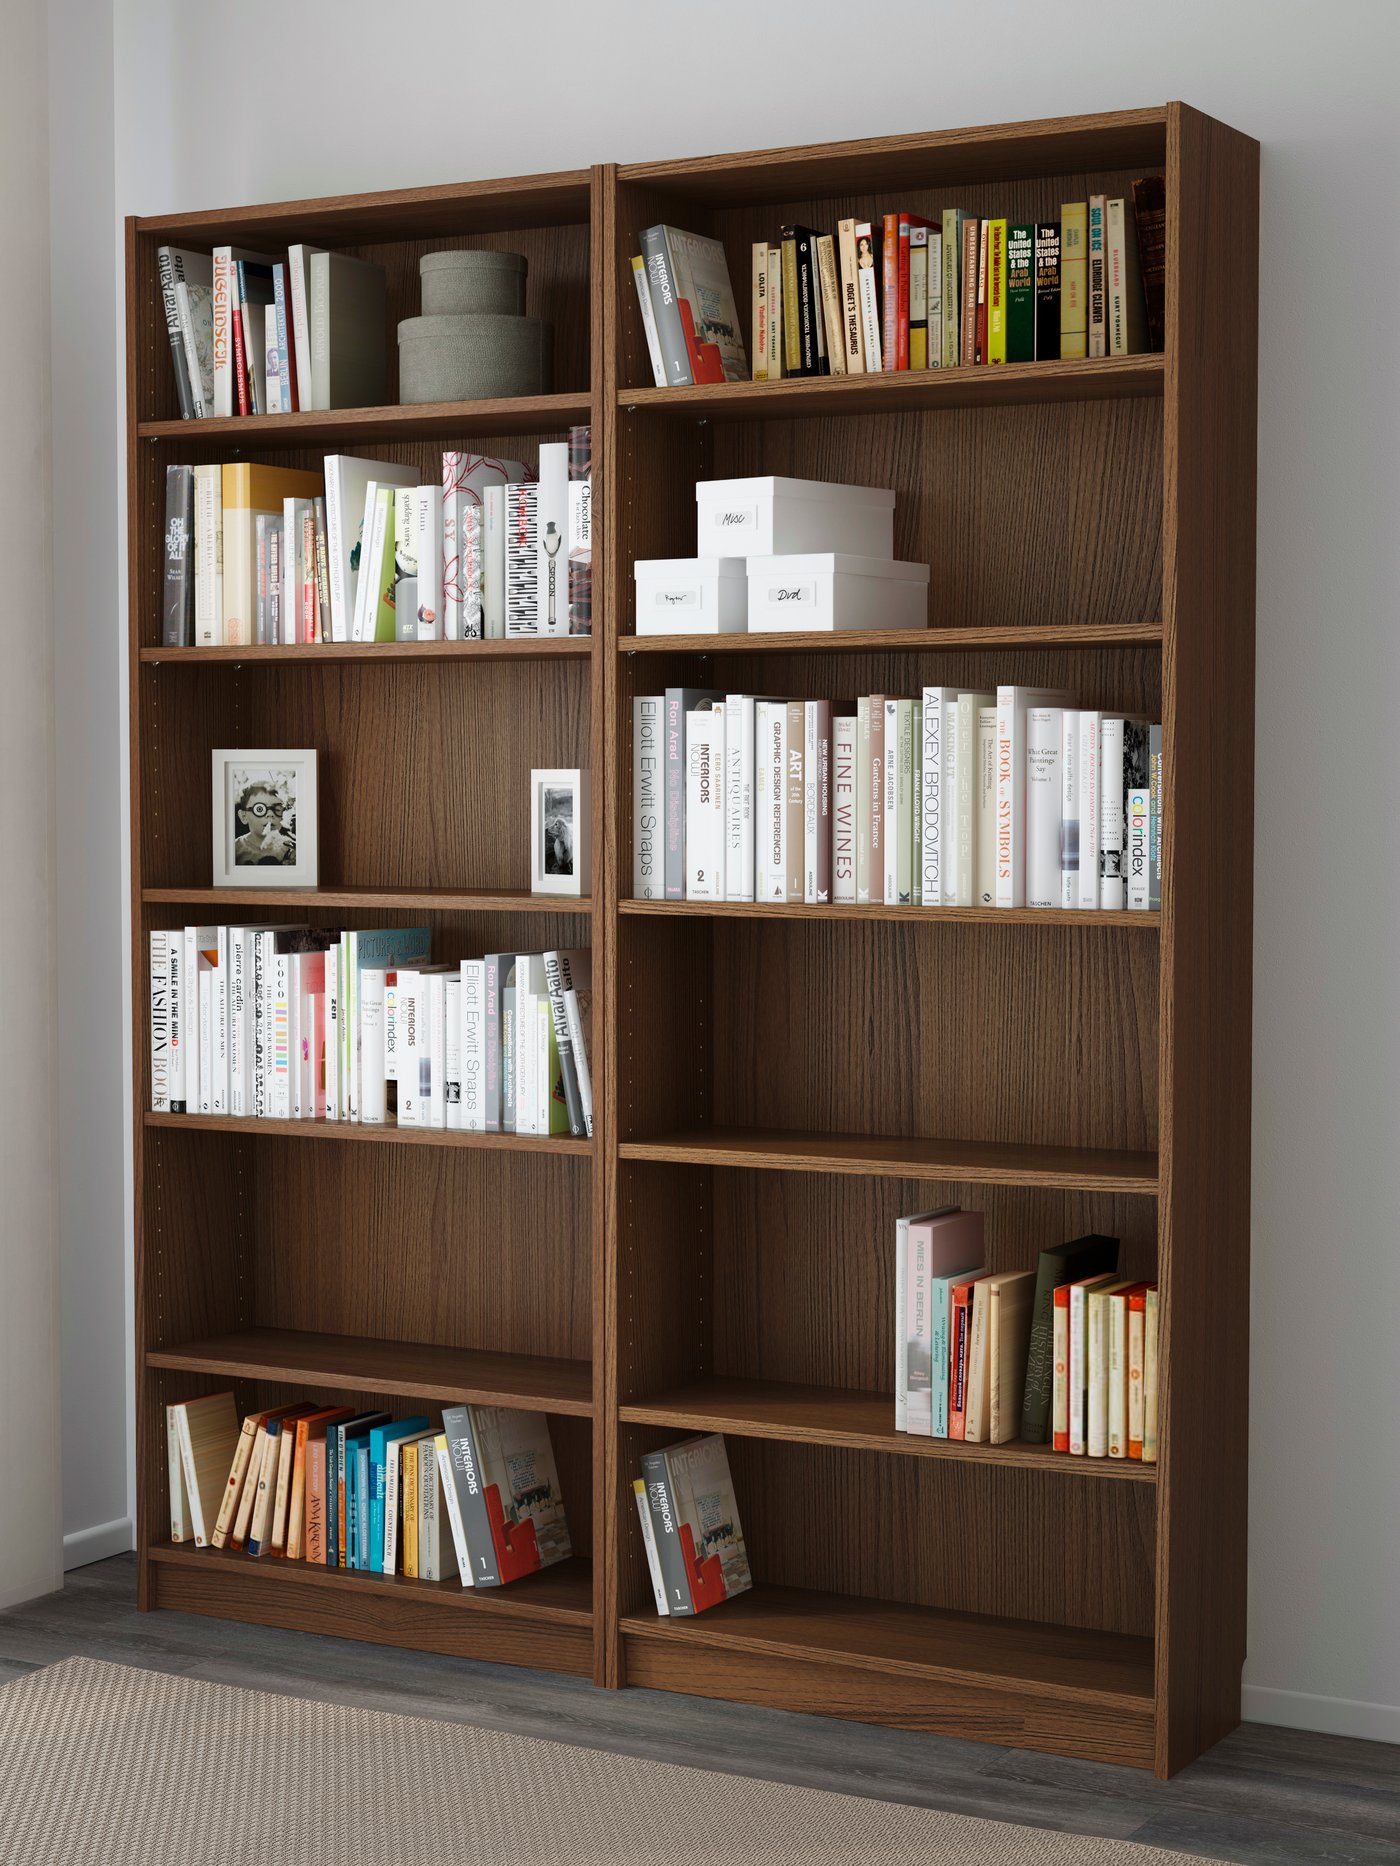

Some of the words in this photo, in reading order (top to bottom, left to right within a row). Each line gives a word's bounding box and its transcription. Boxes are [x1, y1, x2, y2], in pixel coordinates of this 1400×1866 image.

[1092, 208, 1102, 226] SOUL
[800, 243, 808, 252] 6
[1008, 240, 1032, 249] United
[1014, 230, 1026, 240] The
[1036, 237, 1060, 248] United
[1042, 229, 1054, 238] The
[1092, 228, 1102, 239] ON
[1092, 240, 1102, 251] ICE
[968, 226, 976, 288] UNDERSTANDING
[1008, 248, 1032, 260] States
[1010, 260, 1016, 268] &
[1018, 258, 1030, 268] the
[1036, 247, 1060, 256] States
[1038, 258, 1044, 268] &
[1046, 257, 1057, 266] the
[159, 253, 175, 292] Aalto
[648, 256, 660, 285] NOW!
[655, 253, 673, 305] INTERIORS
[1008, 278, 1031, 288] World
[1010, 268, 1028, 278] Arab
[1036, 276, 1058, 286] World
[1038, 267, 1056, 276] Arab
[1092, 259, 1102, 292] ELDRIDGE
[1112, 249, 1120, 287] BLUEBEARD
[274, 278, 282, 301] 2000
[758, 272, 766, 298] LOLITA
[846, 282, 856, 312] ROGET'S
[968, 290, 976, 308] IRAQ
[164, 293, 180, 330] Alvar
[758, 304, 766, 328] Vladimir
[1092, 294, 1102, 324] CLEAVER
[276, 305, 285, 350] ARCHITEKTUR
[758, 330, 766, 354] Nabokov
[849, 314, 858, 355] THESAURUS
[235, 337, 245, 404] SYMBOLISMUS
[280, 360, 288, 385] BERLIN
[674, 360, 680, 371] 1
[170, 518, 184, 526] OH
[402, 494, 415, 524] sparkling
[420, 500, 428, 532] Plum
[518, 490, 528, 546] KOKBOK
[582, 486, 591, 540] Chocolate
[722, 513, 746, 526] Misc
[165, 534, 190, 544] GLORY
[170, 526, 184, 535] THE
[404, 527, 412, 548] wines
[167, 543, 177, 552] OF
[178, 543, 186, 552] IT
[169, 551, 184, 560] ALL
[778, 588, 802, 601] Dvd
[640, 701, 656, 750] Elliott
[669, 700, 679, 726] Ron
[773, 722, 782, 764] GRAPHIC
[924, 692, 939, 766] ALEXEY
[986, 739, 994, 749] The
[669, 730, 679, 760] Arad
[690, 743, 700, 777] NOW!
[986, 750, 994, 759] Art
[700, 744, 710, 804] INTERIORS
[789, 750, 802, 781] ART
[836, 743, 852, 793] FINE
[999, 740, 1010, 784] BOOK
[640, 757, 656, 808] Erwitt
[773, 766, 782, 800] DESIGN
[872, 758, 880, 800] Gardens
[985, 766, 994, 790] Knitting
[1000, 787, 1006, 797] OF
[731, 748, 741, 848] ANTIQUAIRES
[806, 782, 815, 834] BORDEAUX
[872, 802, 880, 812] in
[638, 815, 656, 876] Snaps
[773, 804, 782, 864] REFERENCED
[836, 804, 852, 880] WINES
[872, 814, 880, 848] France
[924, 772, 939, 893] BRODOVITCH
[999, 800, 1010, 878] SYMBOLS
[1132, 796, 1146, 876] colorindex
[696, 870, 704, 882] 2
[152, 934, 168, 970] THE
[234, 944, 242, 974] pierre
[170, 958, 178, 986] SMILE
[466, 964, 480, 1006] Elliott
[546, 959, 562, 998] Aalto
[170, 988, 178, 998] IN
[152, 976, 168, 1052] FASHION
[170, 1000, 178, 1018] THE
[387, 992, 397, 1052] colorindex
[408, 998, 416, 1046] INTERIORS
[552, 1000, 568, 1037] Alvar
[170, 1021, 178, 1046] MIND
[466, 1011, 480, 1053] Erwitt
[464, 1059, 480, 1110] Snaps
[406, 1100, 412, 1110] 2
[916, 1240, 924, 1272] MIES
[916, 1275, 924, 1289] IN
[916, 1292, 924, 1337] BERLIN
[1030, 1326, 1040, 1353] NEW
[1035, 1326, 1048, 1379] HISTORY
[1024, 1355, 1036, 1412] ZEALAND
[1032, 1380, 1040, 1392] of
[1041, 1354, 1053, 1406] PENGUIN
[450, 1439, 465, 1470] NOW!
[460, 1438, 478, 1495] INTERIORS
[376, 1464, 386, 1498] difficult
[309, 1492, 321, 1520] ANNA
[648, 1483, 662, 1512] NOW!
[656, 1482, 673, 1534] INTERIORS
[428, 1512, 434, 1520] OF
[480, 1556, 486, 1569] 1
[676, 1589, 681, 1600] 1
